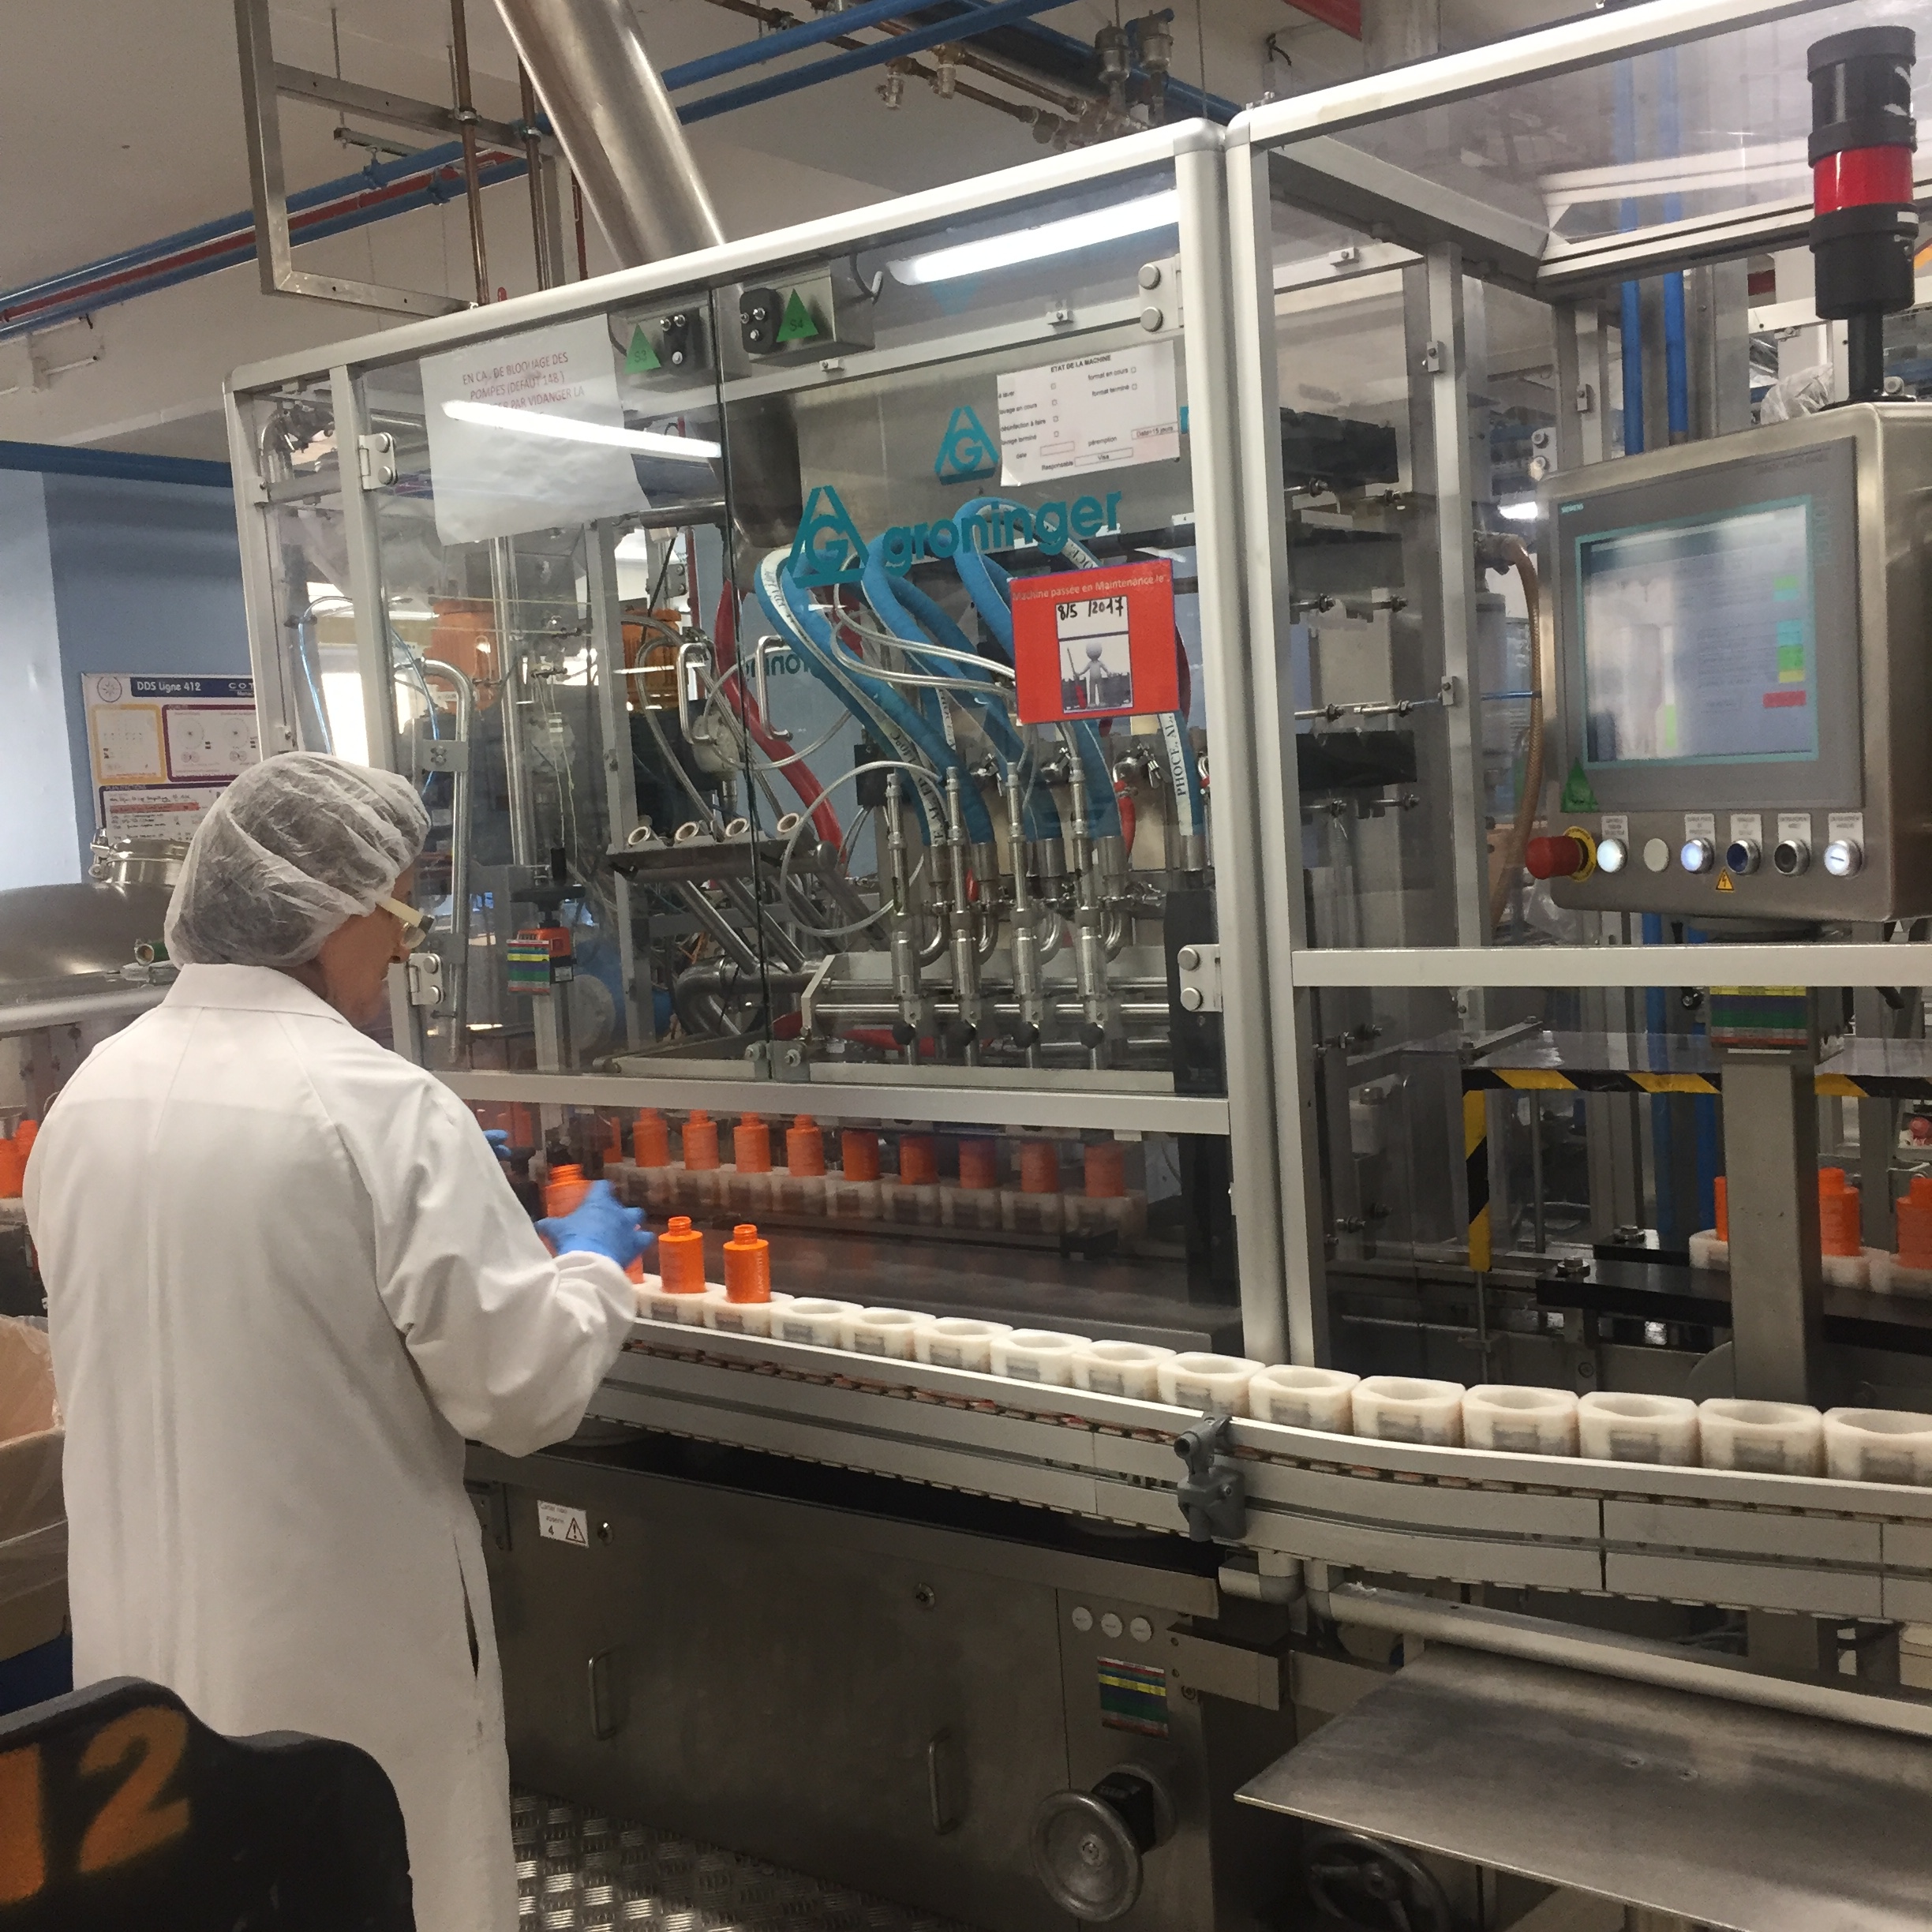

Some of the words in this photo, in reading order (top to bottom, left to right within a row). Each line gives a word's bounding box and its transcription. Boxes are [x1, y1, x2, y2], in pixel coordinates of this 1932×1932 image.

[789, 318, 803, 332] S4
[634, 350, 647, 363] S3
[1050, 364, 1065, 373] ETAT
[1066, 361, 1075, 370] DE
[1084, 354, 1111, 366] MACHINE
[462, 373, 474, 386] EN
[476, 370, 492, 383] CA
[493, 366, 504, 379] DE
[552, 351, 569, 365] DES
[1088, 371, 1105, 380] format
[1114, 368, 1129, 376] cours
[470, 384, 506, 400] POMPES
[507, 376, 541, 394] (DEFAUT
[543, 372, 560, 386] 148
[1091, 388, 1109, 397] format
[511, 397, 527, 410] PAR
[528, 388, 575, 407] VIDANGER
[575, 385, 586, 398] LA
[882, 490, 1122, 578] groninger
[1012, 588, 1049, 601] Machine
[1050, 586, 1080, 598] passée
[1081, 584, 1093, 593] en
[1095, 575, 1155, 591] Maintenance
[137, 681, 156, 691] DDS
[158, 682, 182, 694] Ligne
[183, 681, 202, 691] 412
